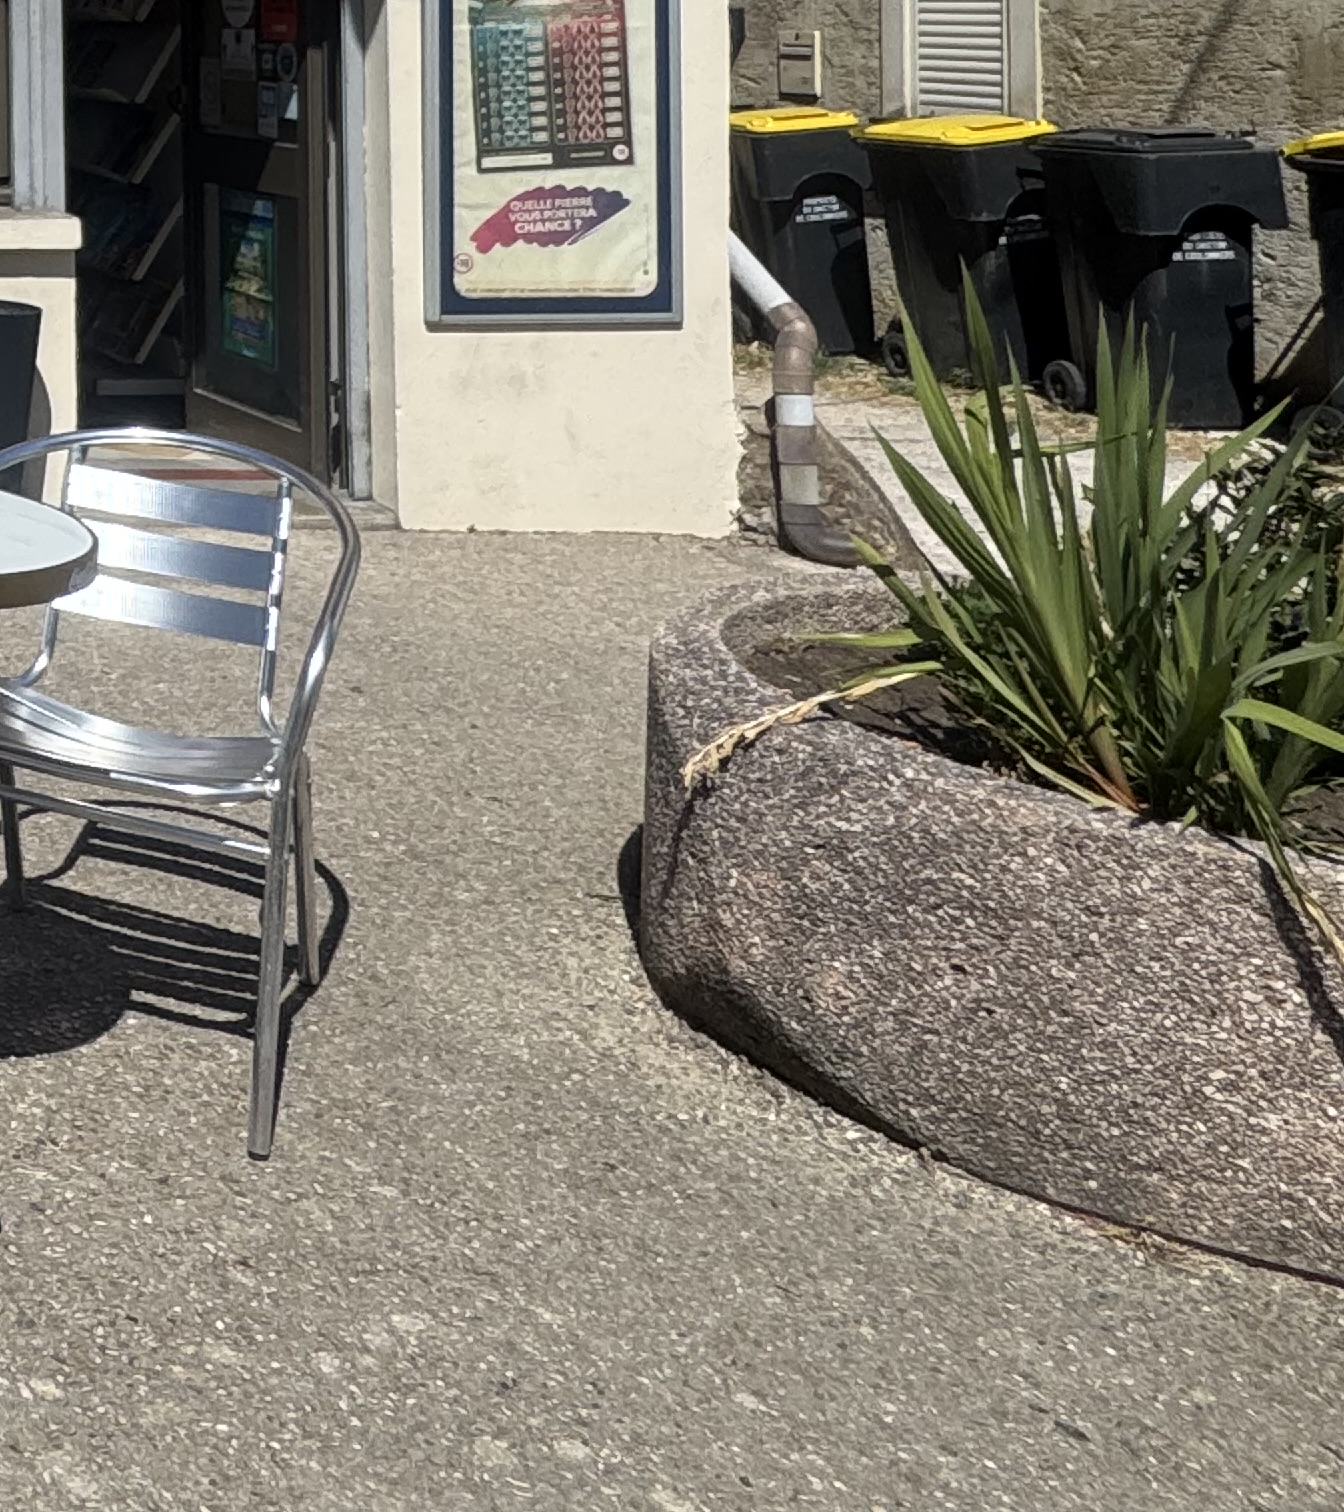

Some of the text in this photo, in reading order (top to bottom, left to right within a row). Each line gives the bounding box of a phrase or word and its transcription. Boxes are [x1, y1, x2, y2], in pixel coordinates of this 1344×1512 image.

[509, 195, 594, 211] QUELLE PIERRE
[542, 207, 598, 220] PORTERA
[514, 220, 569, 234] CHANCE
